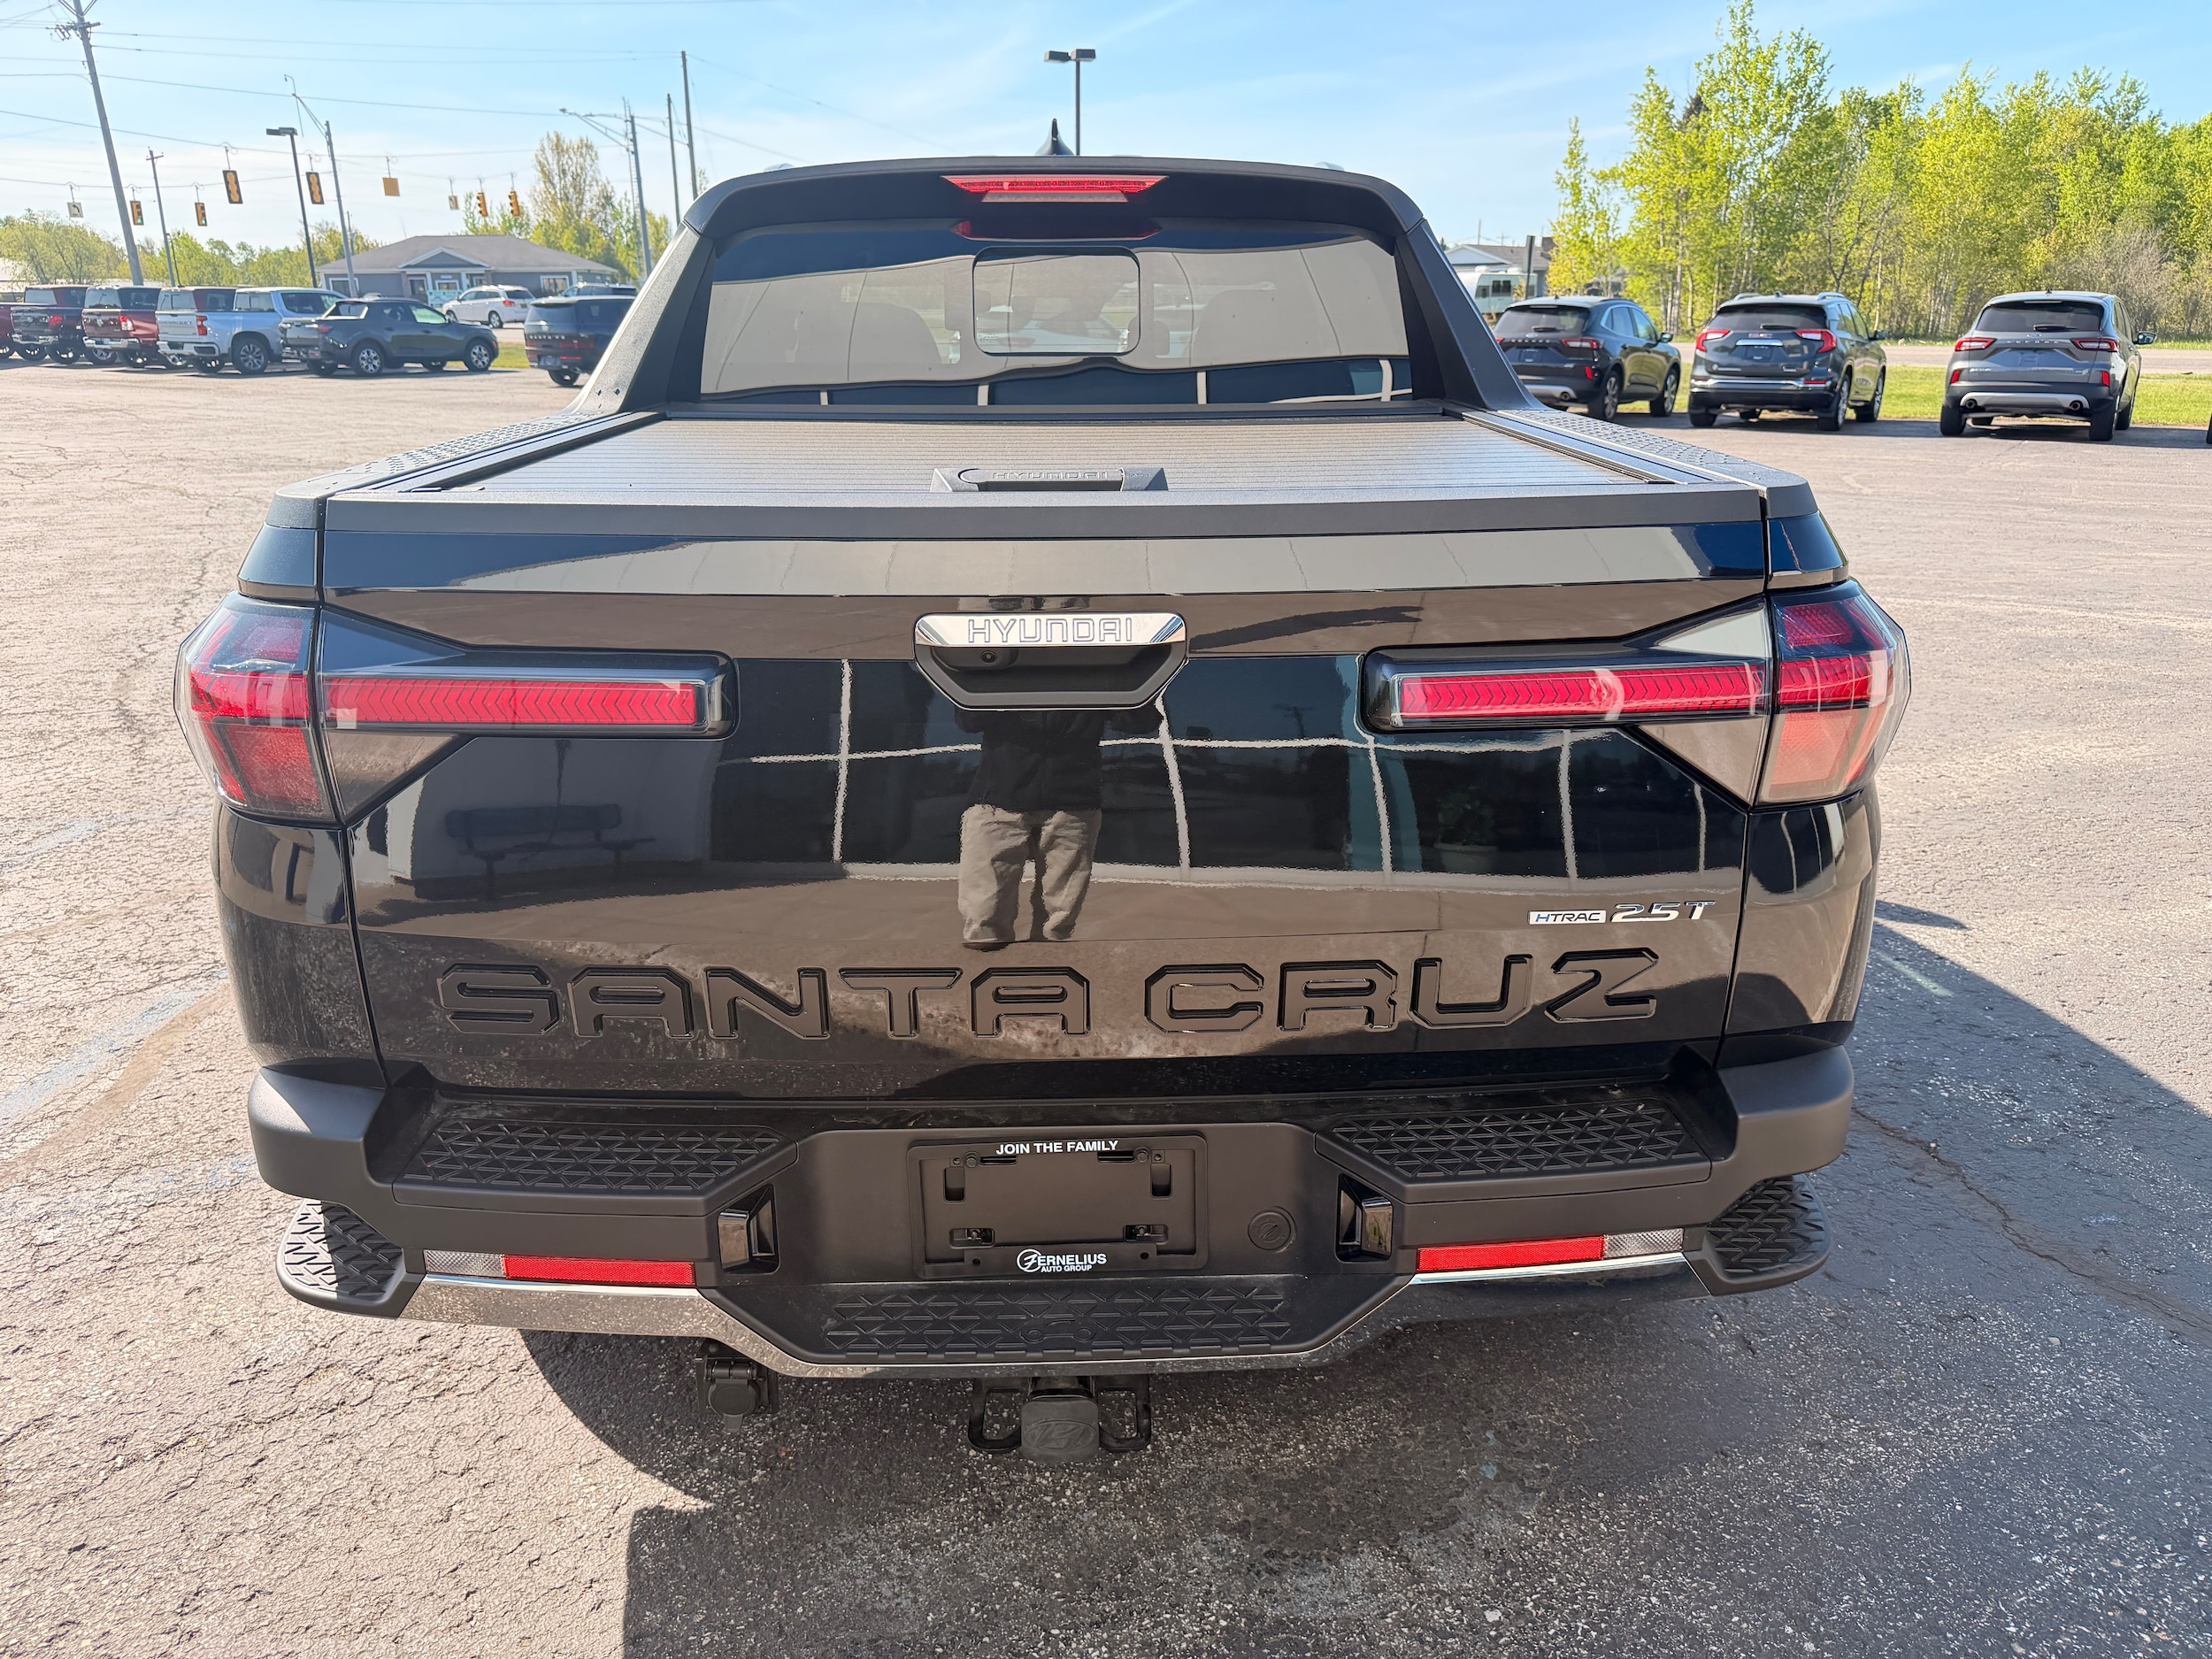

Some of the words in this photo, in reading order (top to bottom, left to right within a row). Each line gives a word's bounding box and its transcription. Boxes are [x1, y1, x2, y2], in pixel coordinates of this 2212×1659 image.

[993, 472, 1108, 480] HYUNDAI
[968, 618, 1133, 643] HYUNDAI
[1535, 912, 1601, 923] HTRAC
[435, 963, 1092, 1041] SANTA
[1144, 948, 1659, 1033] CRUZ
[996, 1144, 1030, 1155] JOIN
[1033, 1142, 1063, 1154] THE
[1067, 1140, 1119, 1152] FAMILY
